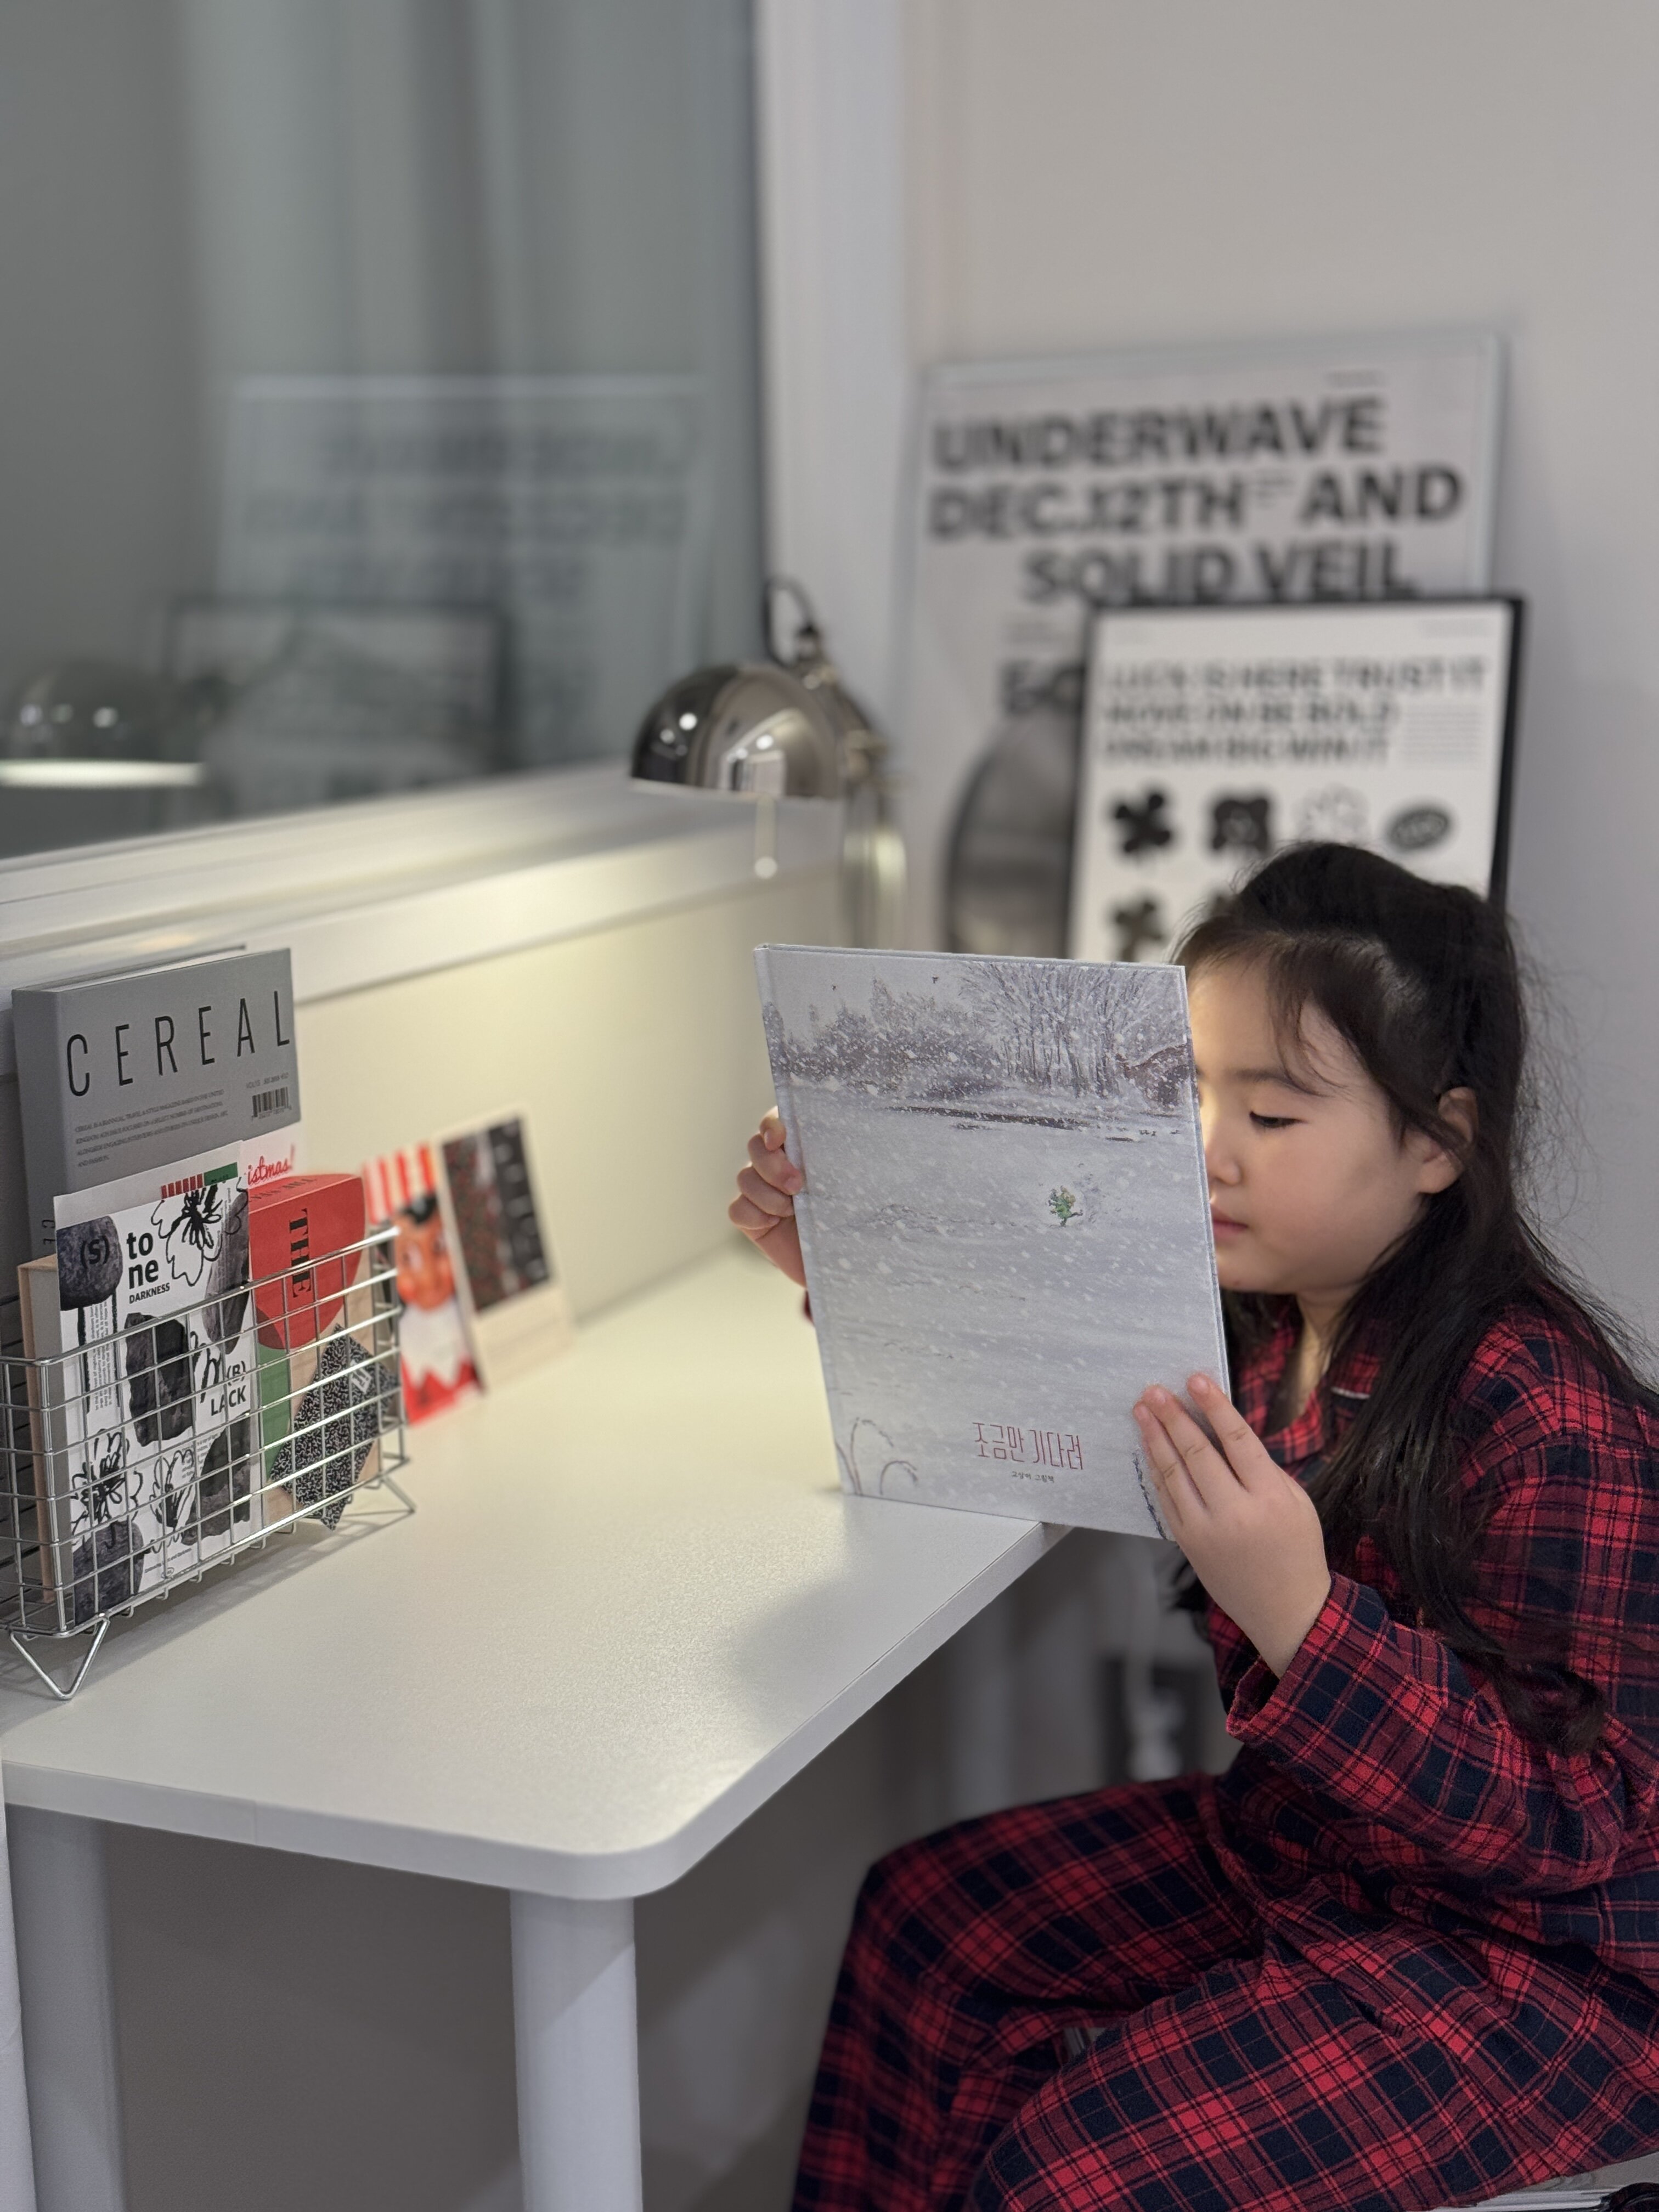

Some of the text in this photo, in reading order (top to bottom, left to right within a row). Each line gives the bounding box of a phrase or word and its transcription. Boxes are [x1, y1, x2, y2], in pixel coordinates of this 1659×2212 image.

[930, 395, 1386, 473] UNDERWAVE
[1298, 464, 1467, 528] AND
[1020, 539, 1411, 601] SOLID VEIL
[66, 990, 290, 1097] CEREAL
[247, 1143, 295, 1186] istmas!
[80, 1232, 153, 1269] (S) to
[128, 1260, 159, 1289] ne
[289, 1207, 312, 1298] THE
[129, 1283, 170, 1304] DARKNESS
[211, 1385, 246, 1416] LACK
[972, 1422, 1083, 1470] 조금만 기다려
